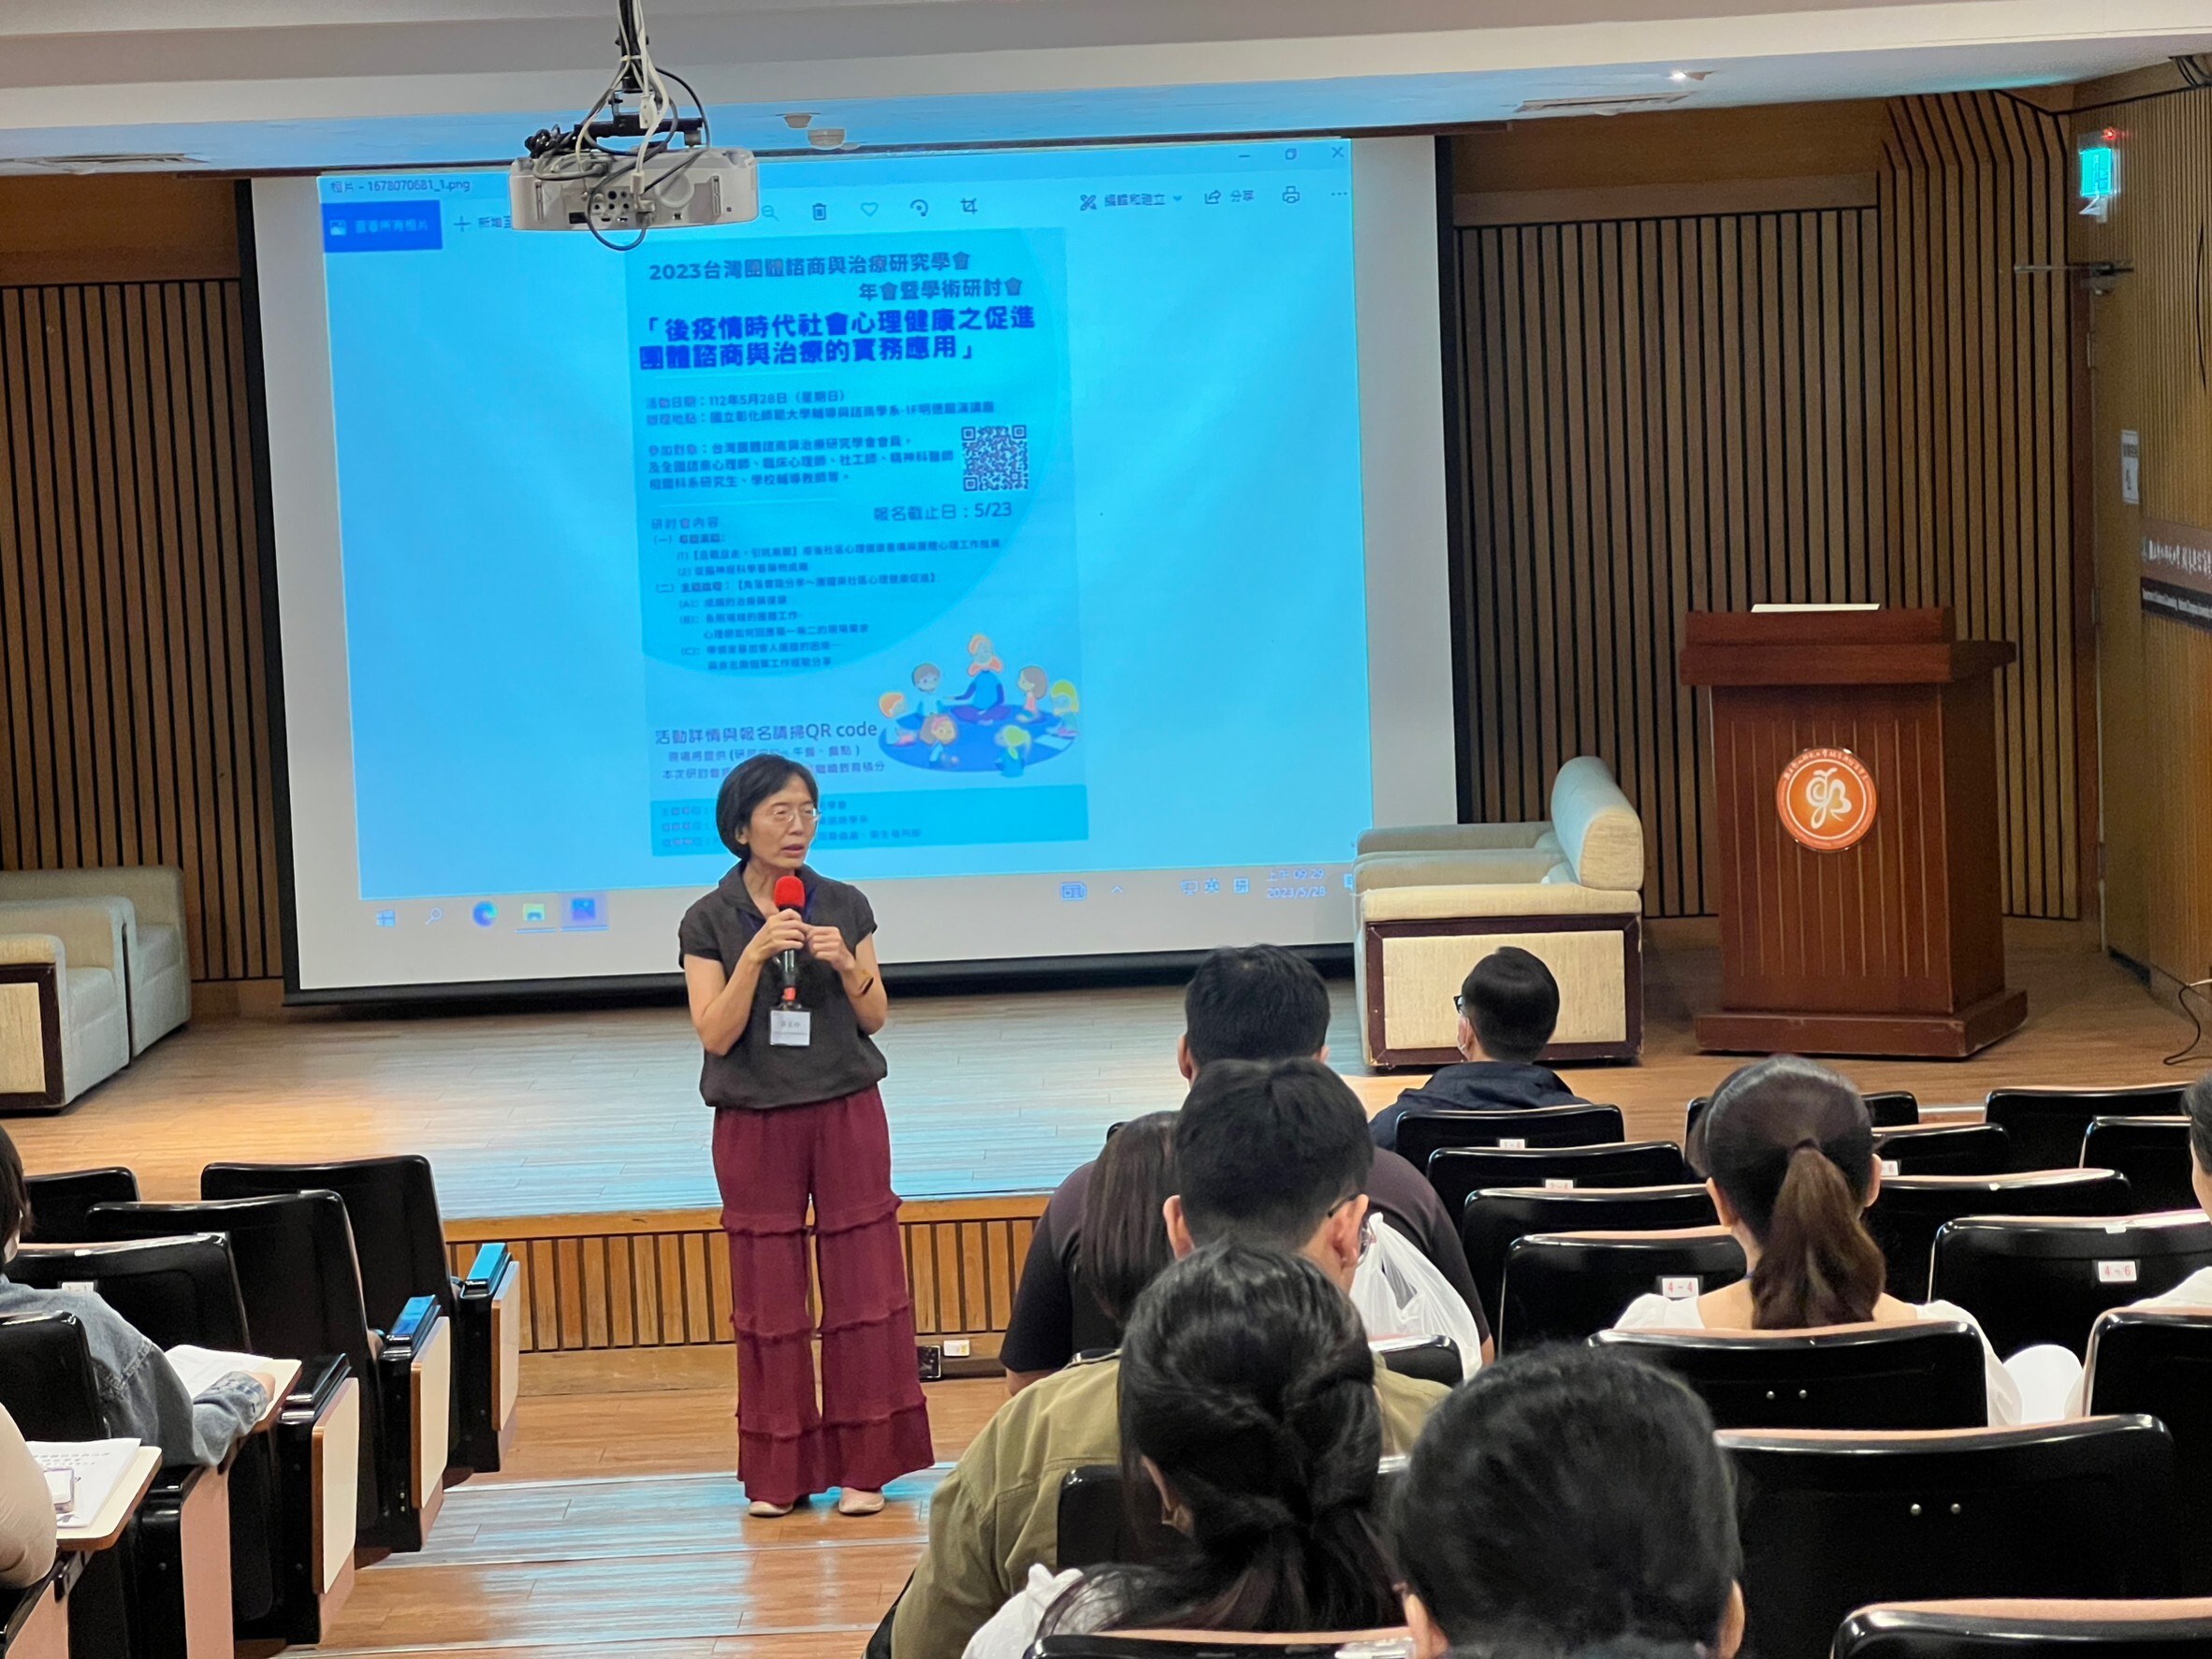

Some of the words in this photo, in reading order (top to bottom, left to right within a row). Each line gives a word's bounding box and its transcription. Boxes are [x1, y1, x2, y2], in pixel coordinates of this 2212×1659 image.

[1230, 189, 1255, 203] 分享
[649, 251, 970, 281] 2023台灣團體諮商與治療研究學會
[859, 277, 1023, 301] 年會暨學術研討會
[648, 305, 1035, 342] 「後疫情時代社會心理健康之促進
[639, 335, 972, 371] 團體諮商與治療的實務應用」
[651, 516, 720, 531] 研討會內容
[655, 723, 831, 745] 活動詳情與報名請掃QR
[836, 721, 877, 737] code
[1267, 886, 1327, 899] 2023/5/28
